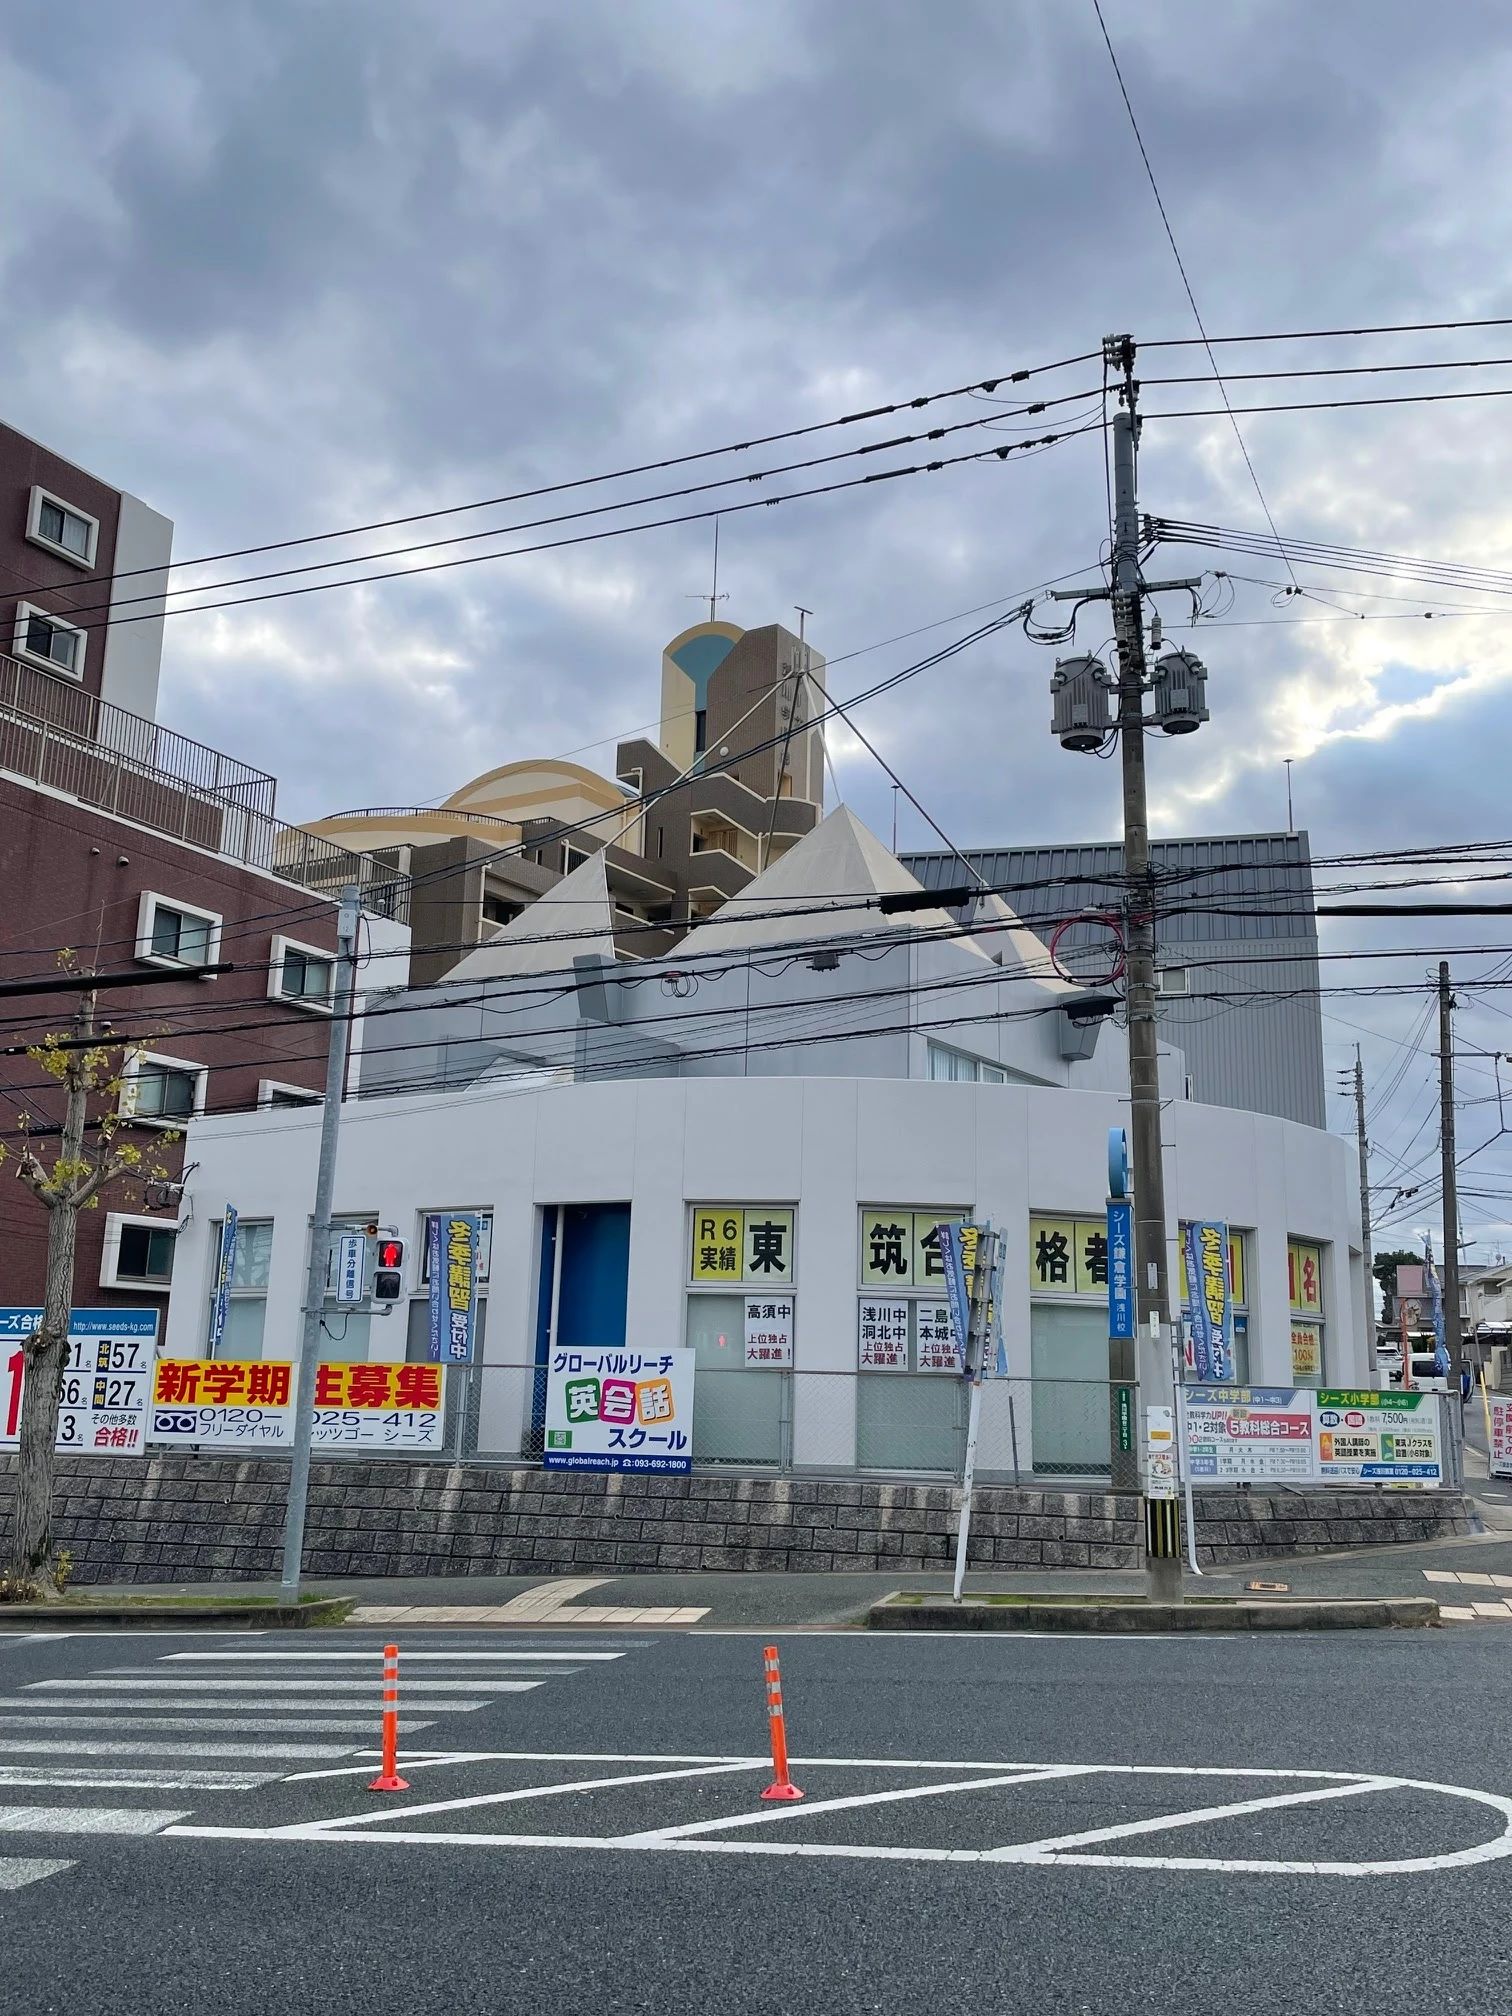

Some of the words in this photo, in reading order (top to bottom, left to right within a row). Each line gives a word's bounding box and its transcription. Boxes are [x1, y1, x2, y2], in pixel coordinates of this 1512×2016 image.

[701, 1219, 738, 1241] R6
[749, 1221, 788, 1273] 東
[1113, 1210, 1127, 1300] シーズ鎌倉学園
[700, 1246, 737, 1271] 実績
[345, 1238, 358, 1299] 歩車分離信号
[747, 1304, 791, 1319] 高須中
[862, 1307, 907, 1323] 浅川中
[919, 1309, 953, 1324] 二島
[1116, 1303, 1127, 1332] 浅川校
[73, 1321, 154, 1333] http://www.seeds-kg.com
[862, 1325, 906, 1340] 洞北中
[747, 1334, 787, 1344] 上位独占
[863, 1342, 904, 1352] 上位独占
[553, 1352, 674, 1375] グローバルリーチ
[568, 1384, 672, 1422] 英会話
[1321, 1392, 1380, 1406] シーズ小学部
[91, 1413, 138, 1426] その他多数
[1230, 1420, 1310, 1436] 5教科総合コース
[94, 1427, 139, 1447] 合格!!
[200, 1424, 284, 1437] フリーダイヤル
[310, 1428, 374, 1441] ッツゴー
[384, 1429, 435, 1442] シーズ
[608, 1428, 687, 1451] スクール
[1493, 1407, 1504, 1459] 駐停車禁止
[549, 1456, 619, 1467] www.globalreach.jp
